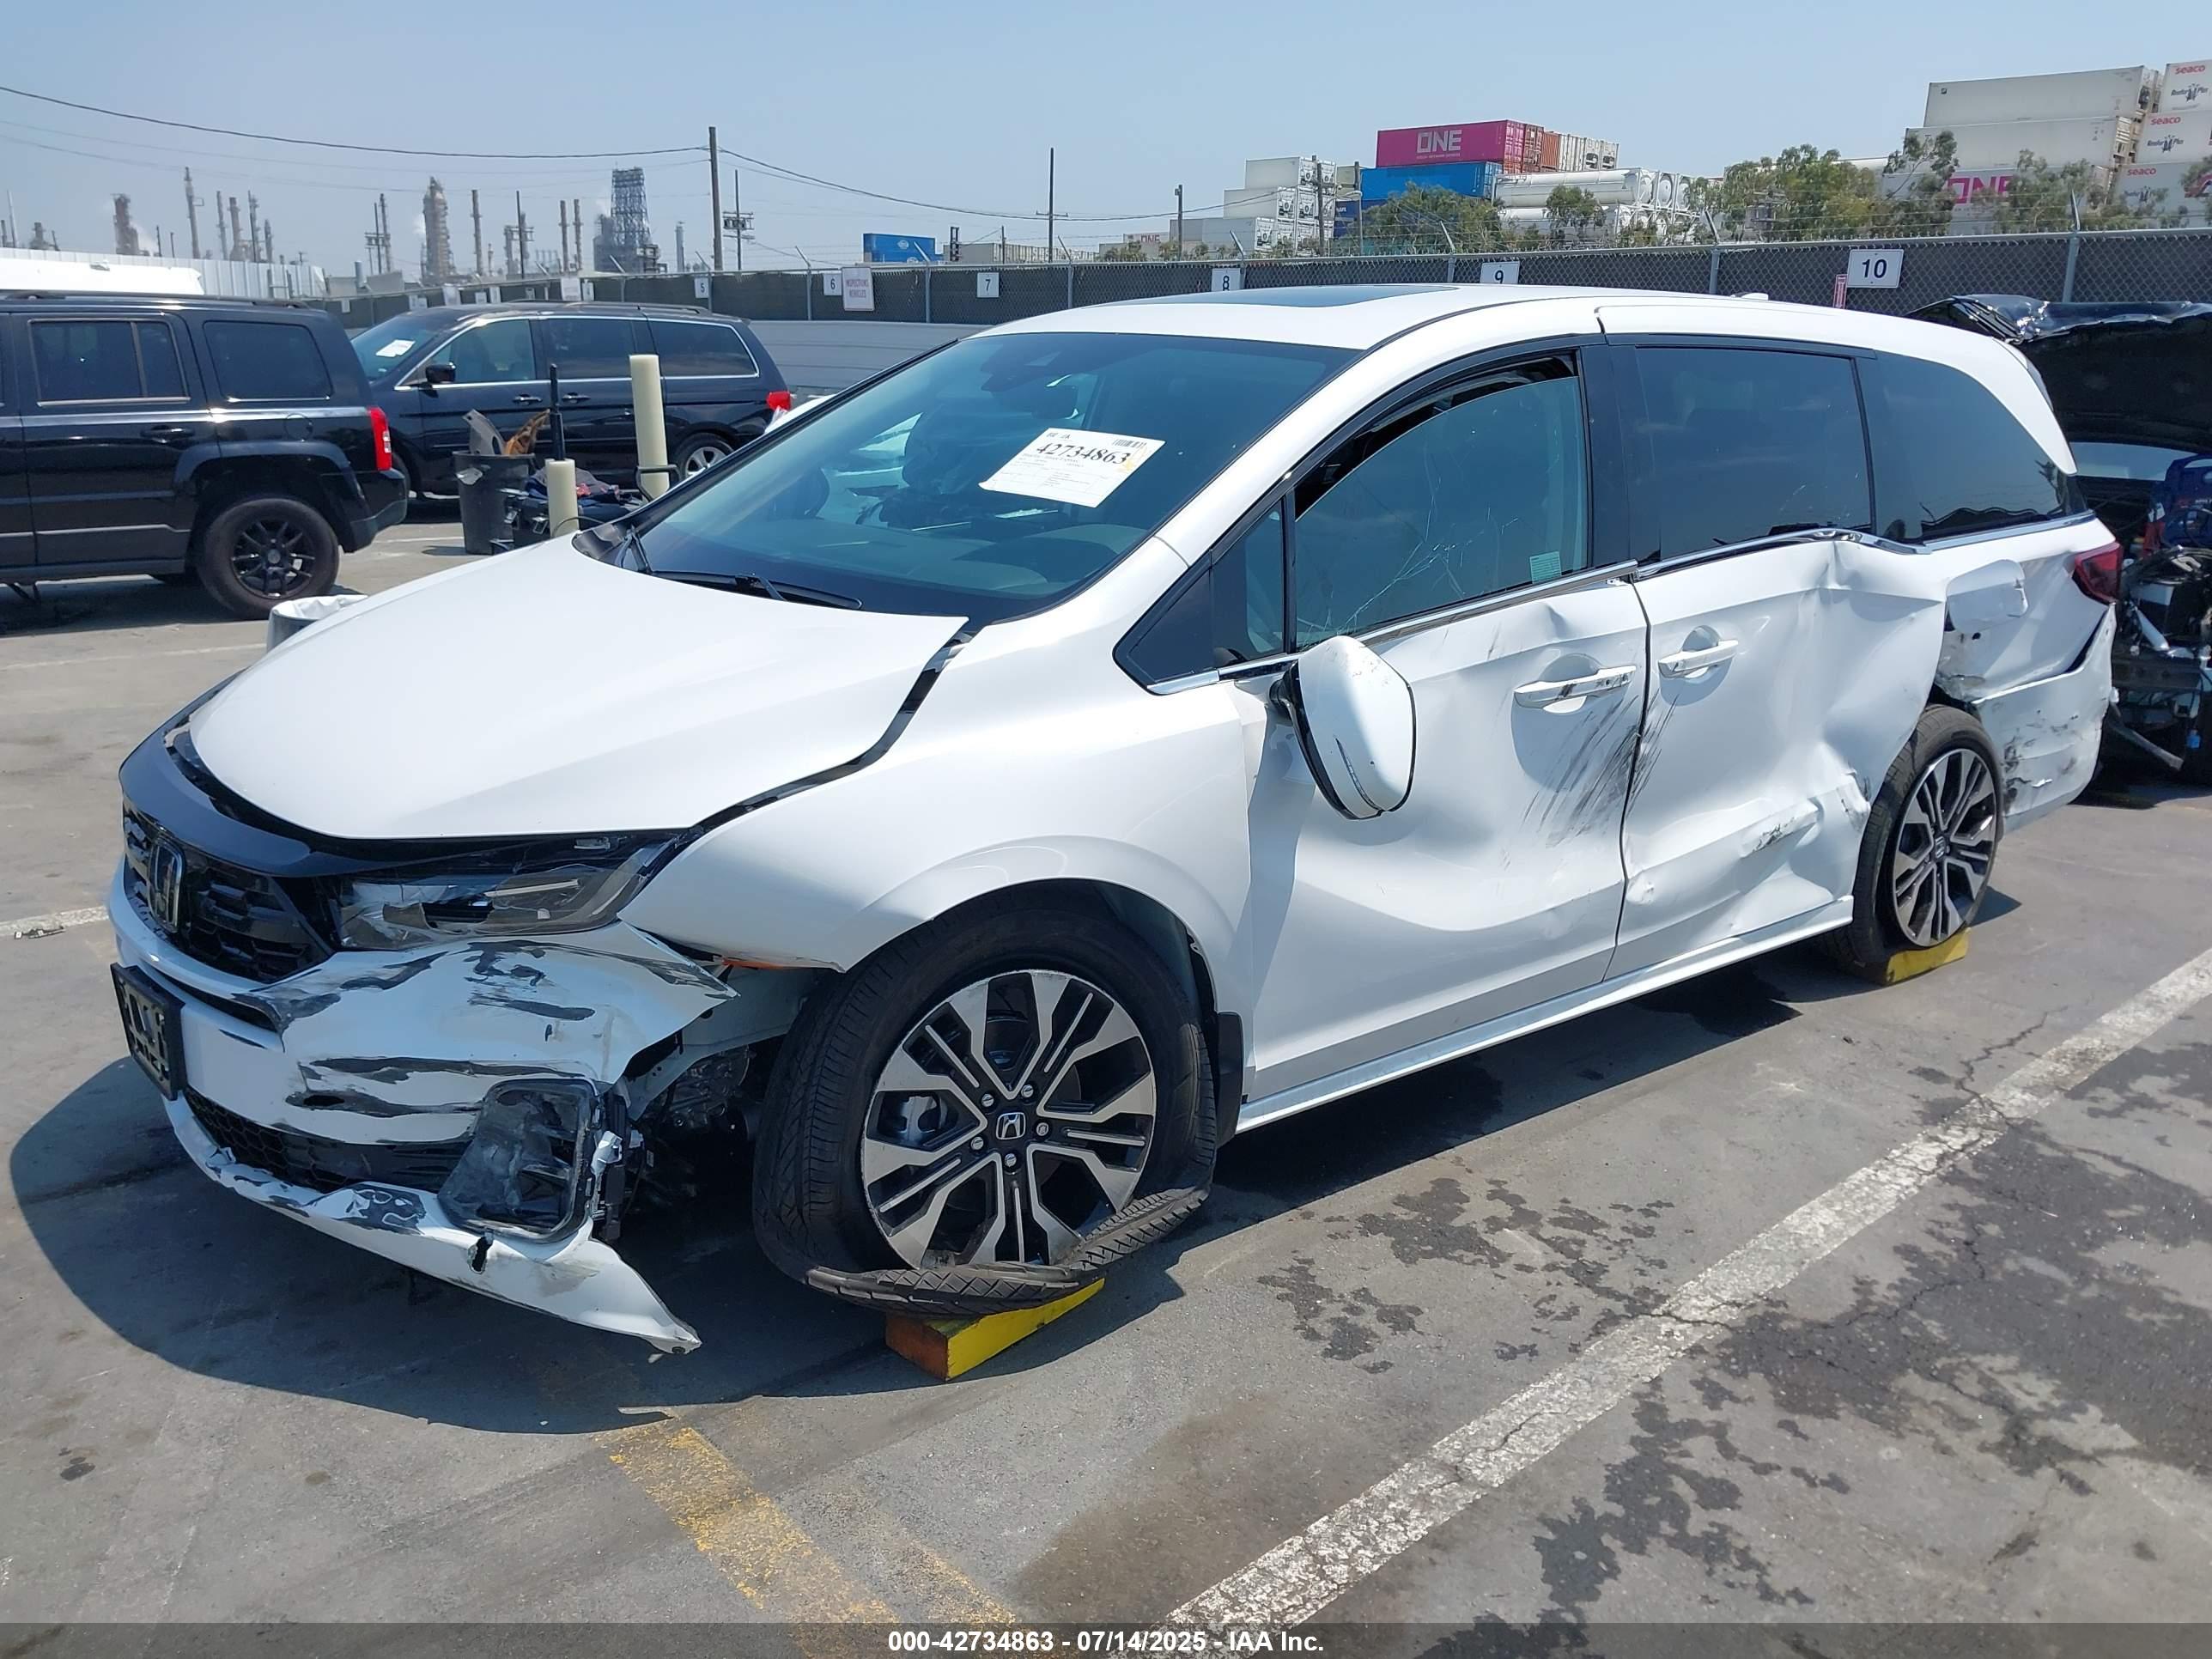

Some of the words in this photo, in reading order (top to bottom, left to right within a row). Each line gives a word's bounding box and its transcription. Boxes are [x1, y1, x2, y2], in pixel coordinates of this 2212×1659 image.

[2175, 64, 2206, 75] seaco
[2149, 117, 2181, 125] seaco
[1417, 130, 1462, 153] ONE
[2127, 167, 2157, 176] seaco
[1862, 258, 1887, 279] 10
[1222, 275, 1230, 291] 8
[1494, 270, 1504, 283] 9
[830, 278, 836, 289] 6
[985, 278, 991, 291] 7
[1036, 442, 1132, 465] 42734863
